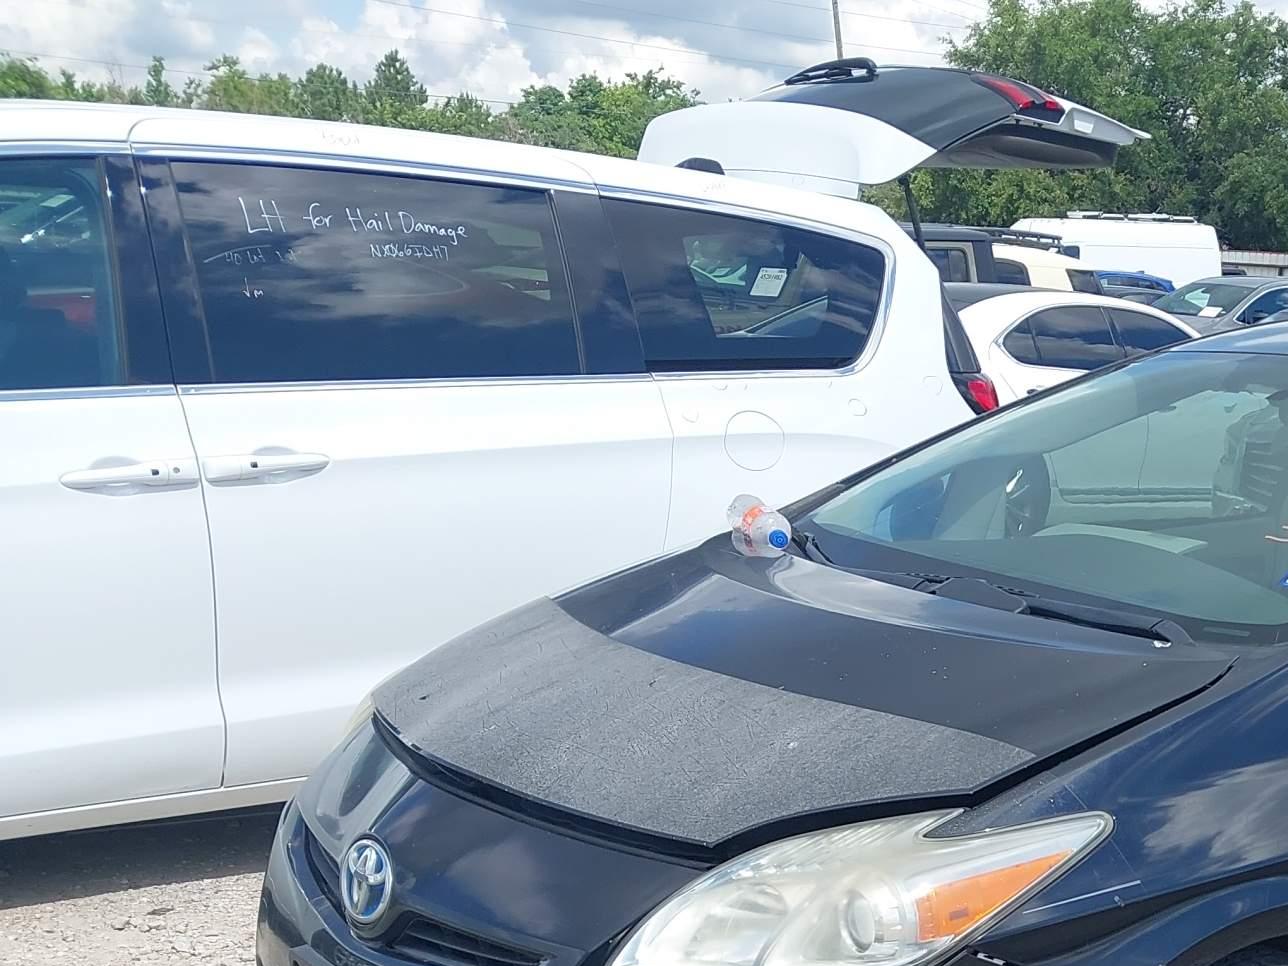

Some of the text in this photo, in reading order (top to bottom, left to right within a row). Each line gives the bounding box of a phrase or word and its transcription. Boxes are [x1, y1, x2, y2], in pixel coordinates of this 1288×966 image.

[237, 197, 470, 246] LH for Hail Damage
